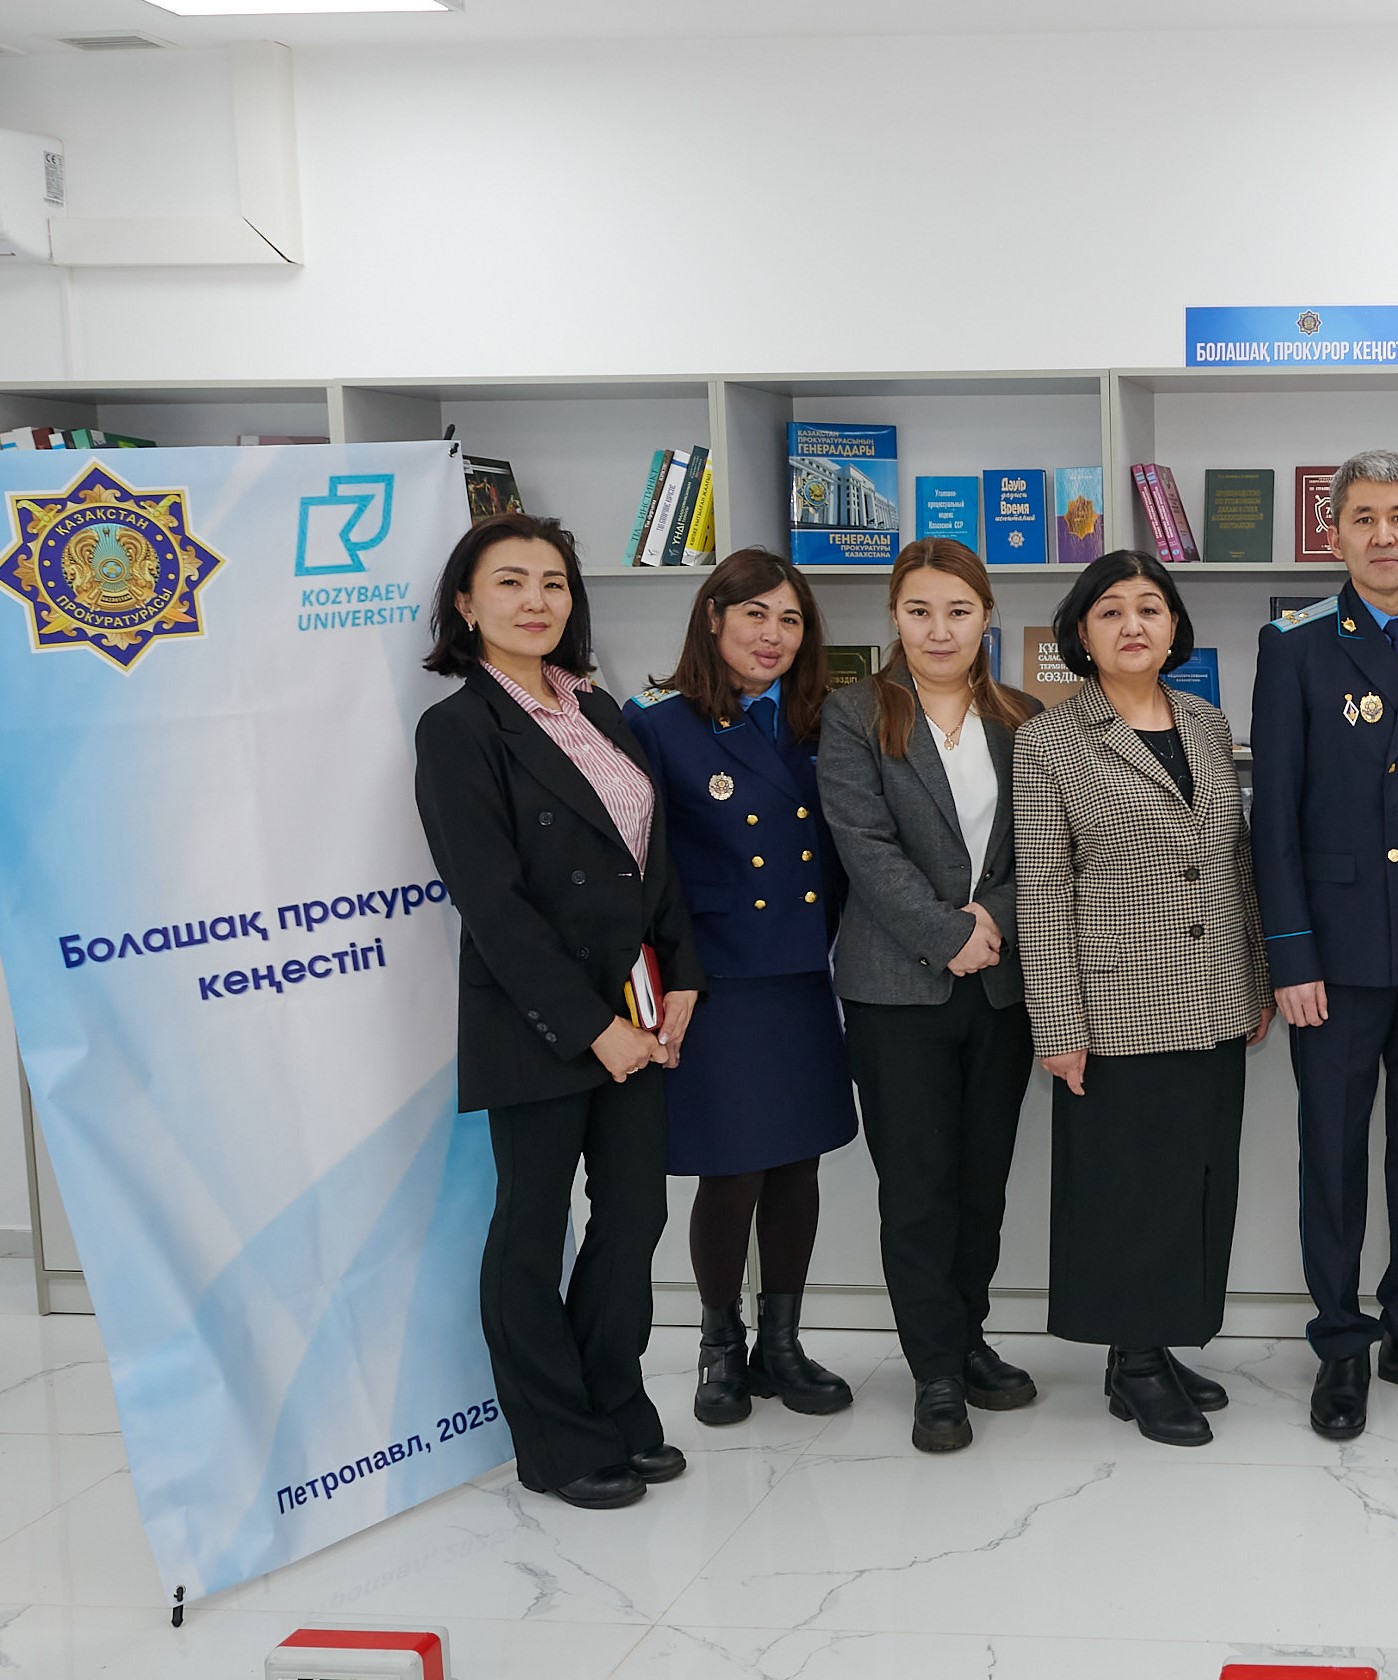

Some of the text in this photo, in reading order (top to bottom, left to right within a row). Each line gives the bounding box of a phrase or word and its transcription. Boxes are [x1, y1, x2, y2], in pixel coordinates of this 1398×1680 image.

[1196, 342, 1271, 362] БОЛАШАҚ
[1274, 341, 1349, 361] ПРОКУРОР
[798, 444, 875, 457] ГЕНЕРАЛДАРЫ
[1000, 501, 1029, 515] Время
[55, 509, 149, 536] ҚАЗАҚСТАН
[829, 534, 891, 545] ГЕНЕРАЛЫ
[56, 588, 173, 627] ПРОКУРАТУРАСЫ
[302, 582, 409, 607] KOZYBAEV
[298, 604, 420, 631] UNIVERSITY
[59, 879, 448, 968] Болашақ прокуро
[198, 937, 386, 1001] кеңестігі
[276, 1398, 499, 1514] Петропавл, 2025
